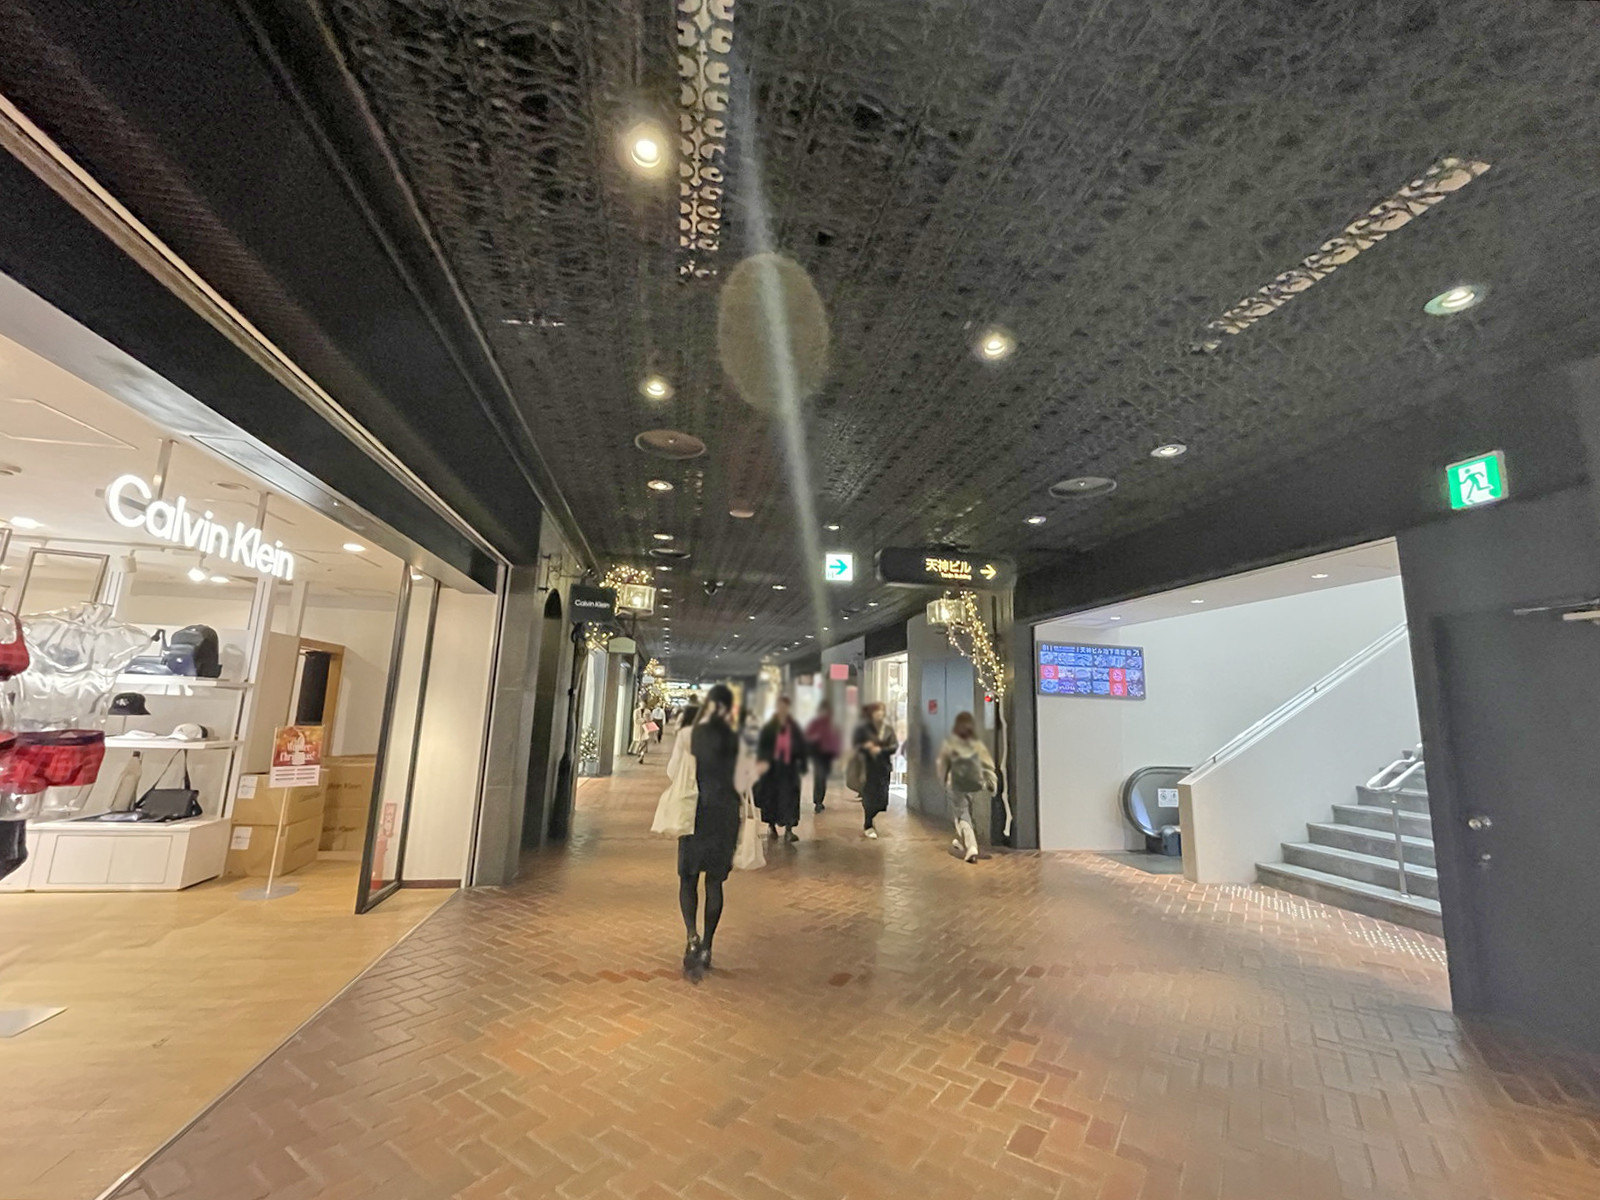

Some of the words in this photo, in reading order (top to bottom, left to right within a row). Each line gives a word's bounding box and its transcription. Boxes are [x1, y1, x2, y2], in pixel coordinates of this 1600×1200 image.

[106, 474, 229, 559] Calvin
[231, 521, 294, 580] Klein
[925, 558, 972, 574] 天神ビル
[574, 599, 595, 607] Calvin
[594, 601, 610, 609] Klein
